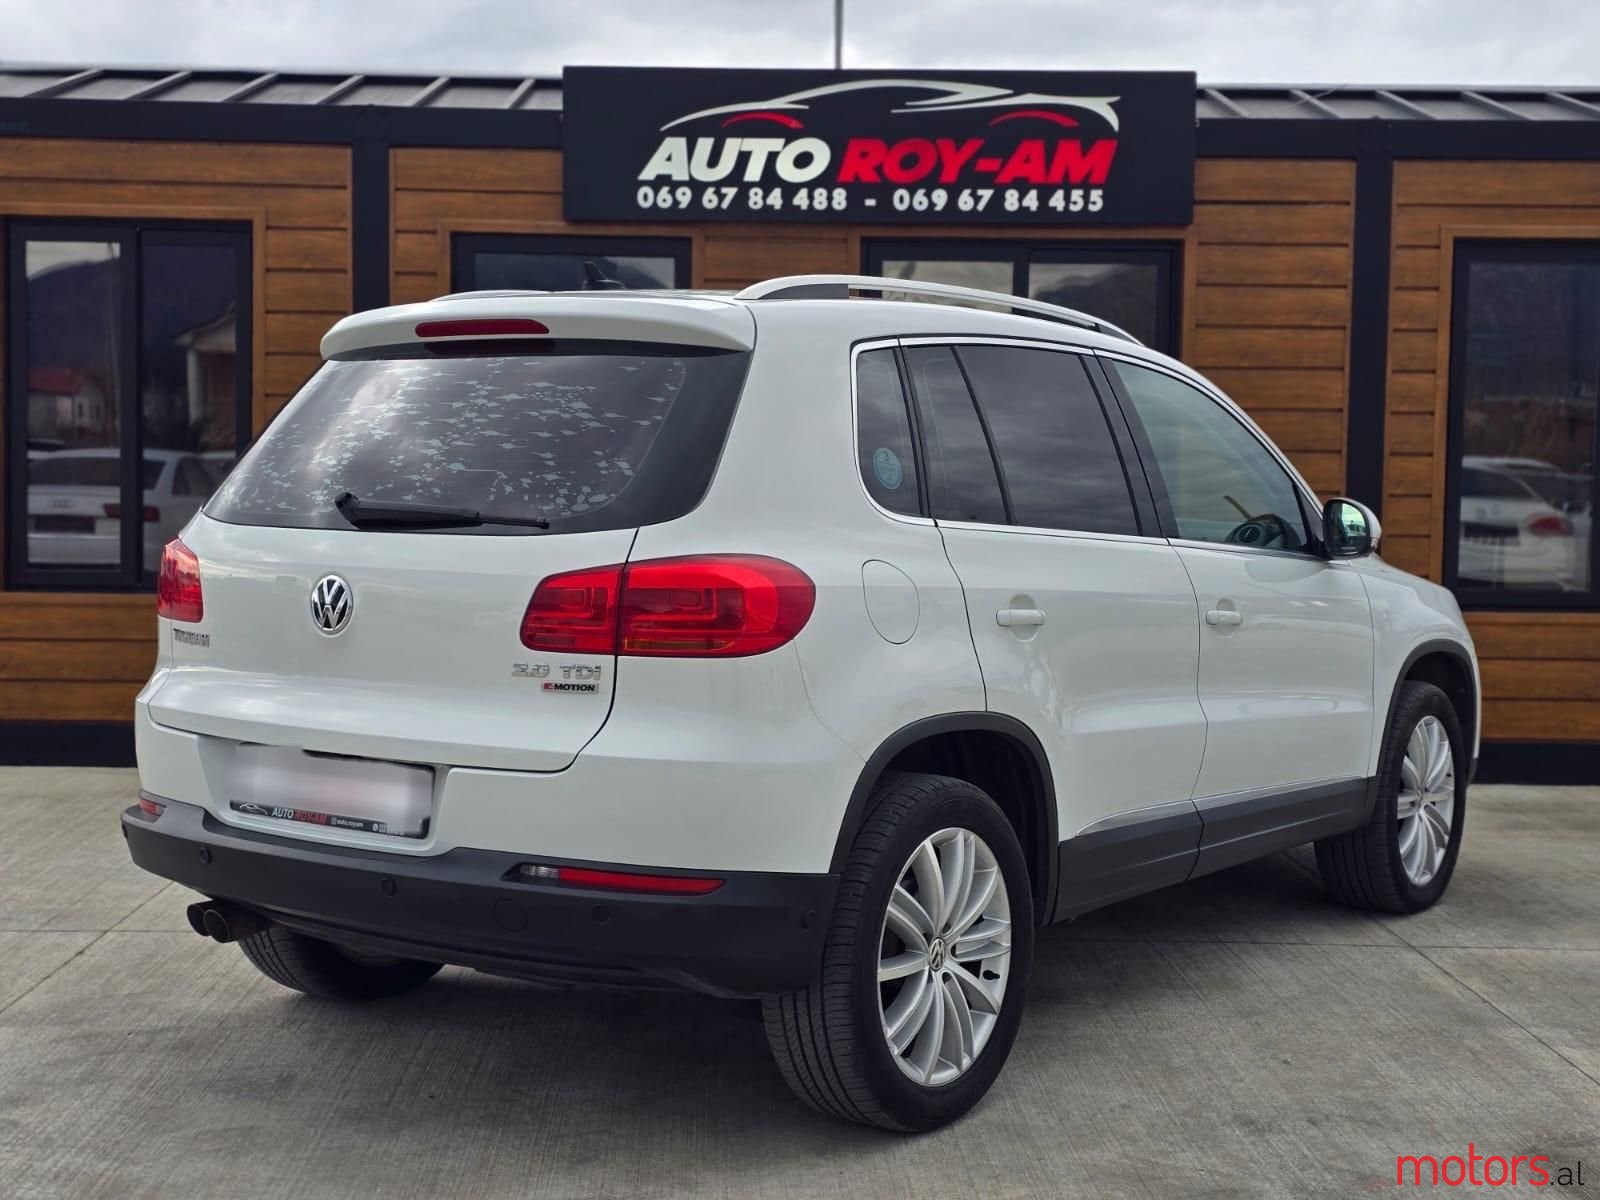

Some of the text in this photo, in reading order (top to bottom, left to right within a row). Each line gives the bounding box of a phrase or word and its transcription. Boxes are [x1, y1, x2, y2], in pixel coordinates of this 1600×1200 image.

[637, 136, 1118, 184] AUTO ROY-AM
[636, 185, 693, 209] 069
[702, 186, 738, 210] 67
[748, 187, 783, 210] 84
[792, 187, 847, 211] 488
[892, 188, 948, 211] 069
[957, 188, 995, 212] 67
[1003, 189, 1039, 212] 84
[1048, 189, 1104, 212] 455
[271, 807, 294, 819] AUTO
